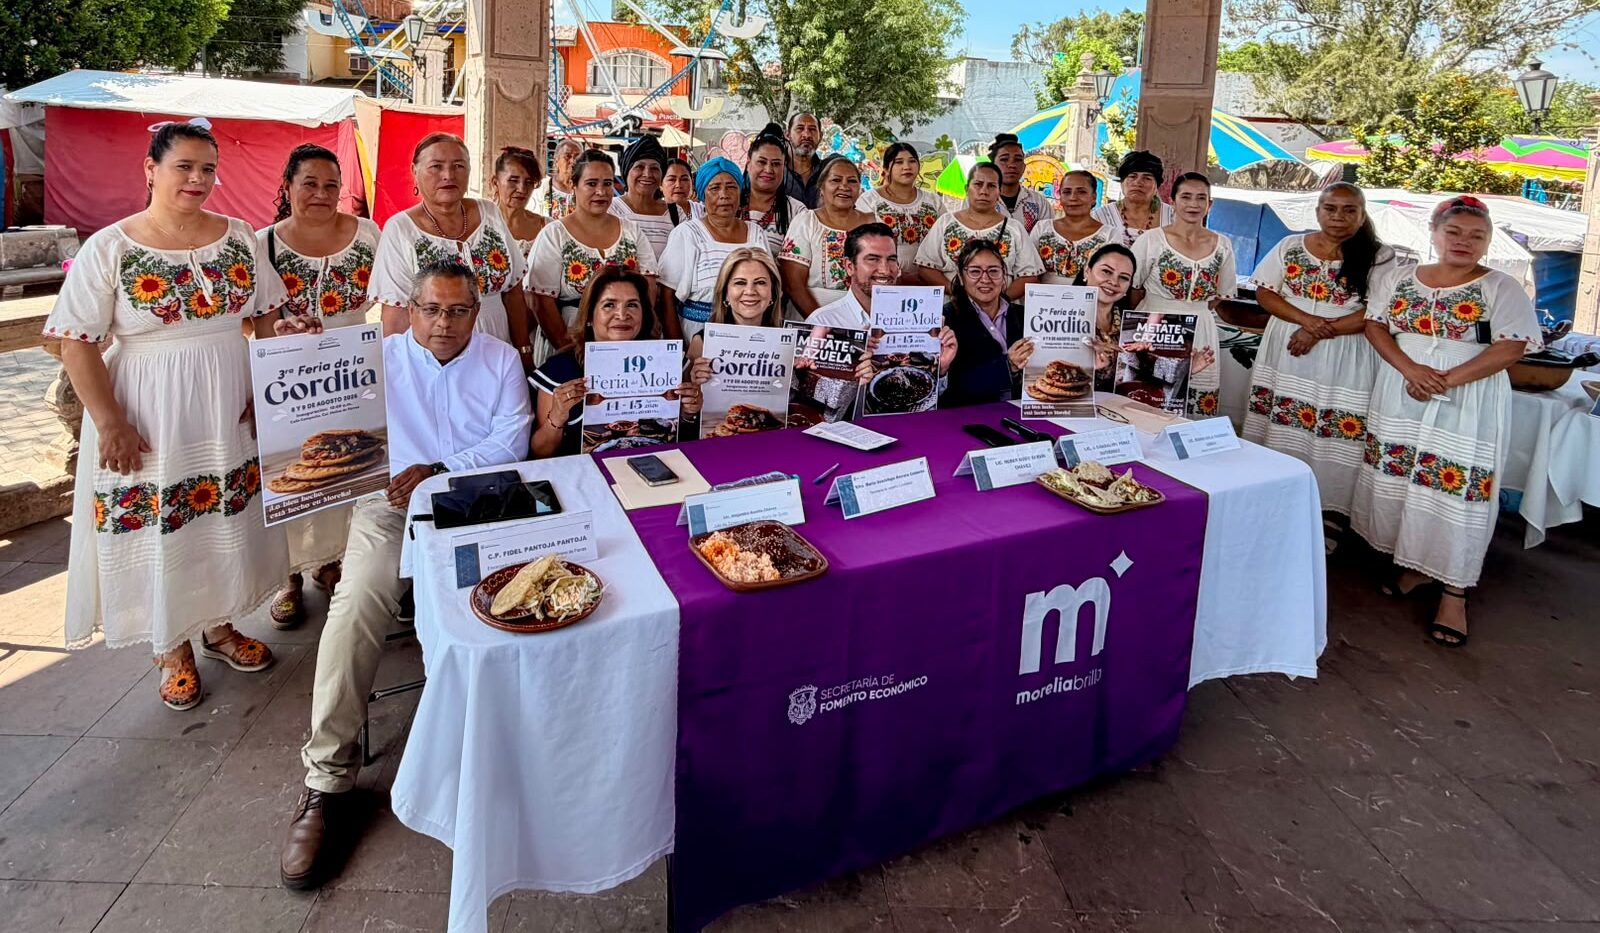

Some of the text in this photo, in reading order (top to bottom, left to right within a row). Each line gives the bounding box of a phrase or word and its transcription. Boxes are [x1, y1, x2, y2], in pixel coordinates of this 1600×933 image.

[875, 313, 904, 325] Feria
[912, 313, 939, 325] Mole
[1049, 308, 1067, 316] Feria
[1030, 315, 1090, 334] Gordita
[1136, 323, 1182, 334] METATE
[361, 329, 376, 341] m
[781, 334, 792, 343] m
[1133, 333, 1184, 344] CAZUELA
[667, 343, 677, 351] m
[798, 336, 850, 353] METATE
[733, 350, 756, 359] Feria
[771, 352, 780, 360] la
[794, 347, 852, 365] CAZUELA
[298, 362, 330, 376] Feria
[334, 358, 350, 368] de
[353, 355, 365, 365] la
[709, 357, 786, 377] Gordita
[265, 368, 377, 405] Gordita
[590, 374, 629, 389] Feria
[640, 371, 677, 387] Mole
[317, 397, 342, 406] AGOSTO
[630, 400, 642, 409] 15
[323, 489, 352, 503] Morelia!
[488, 552, 501, 560] C.P.
[503, 548, 522, 557] FIDEL
[524, 542, 555, 553] PANTOJA
[557, 535, 587, 546] PANTOJA
[1019, 576, 1111, 675] m
[820, 674, 895, 700] SECRETARÍA DE
[820, 675, 928, 714] FOMENTO ECONÓMICO
